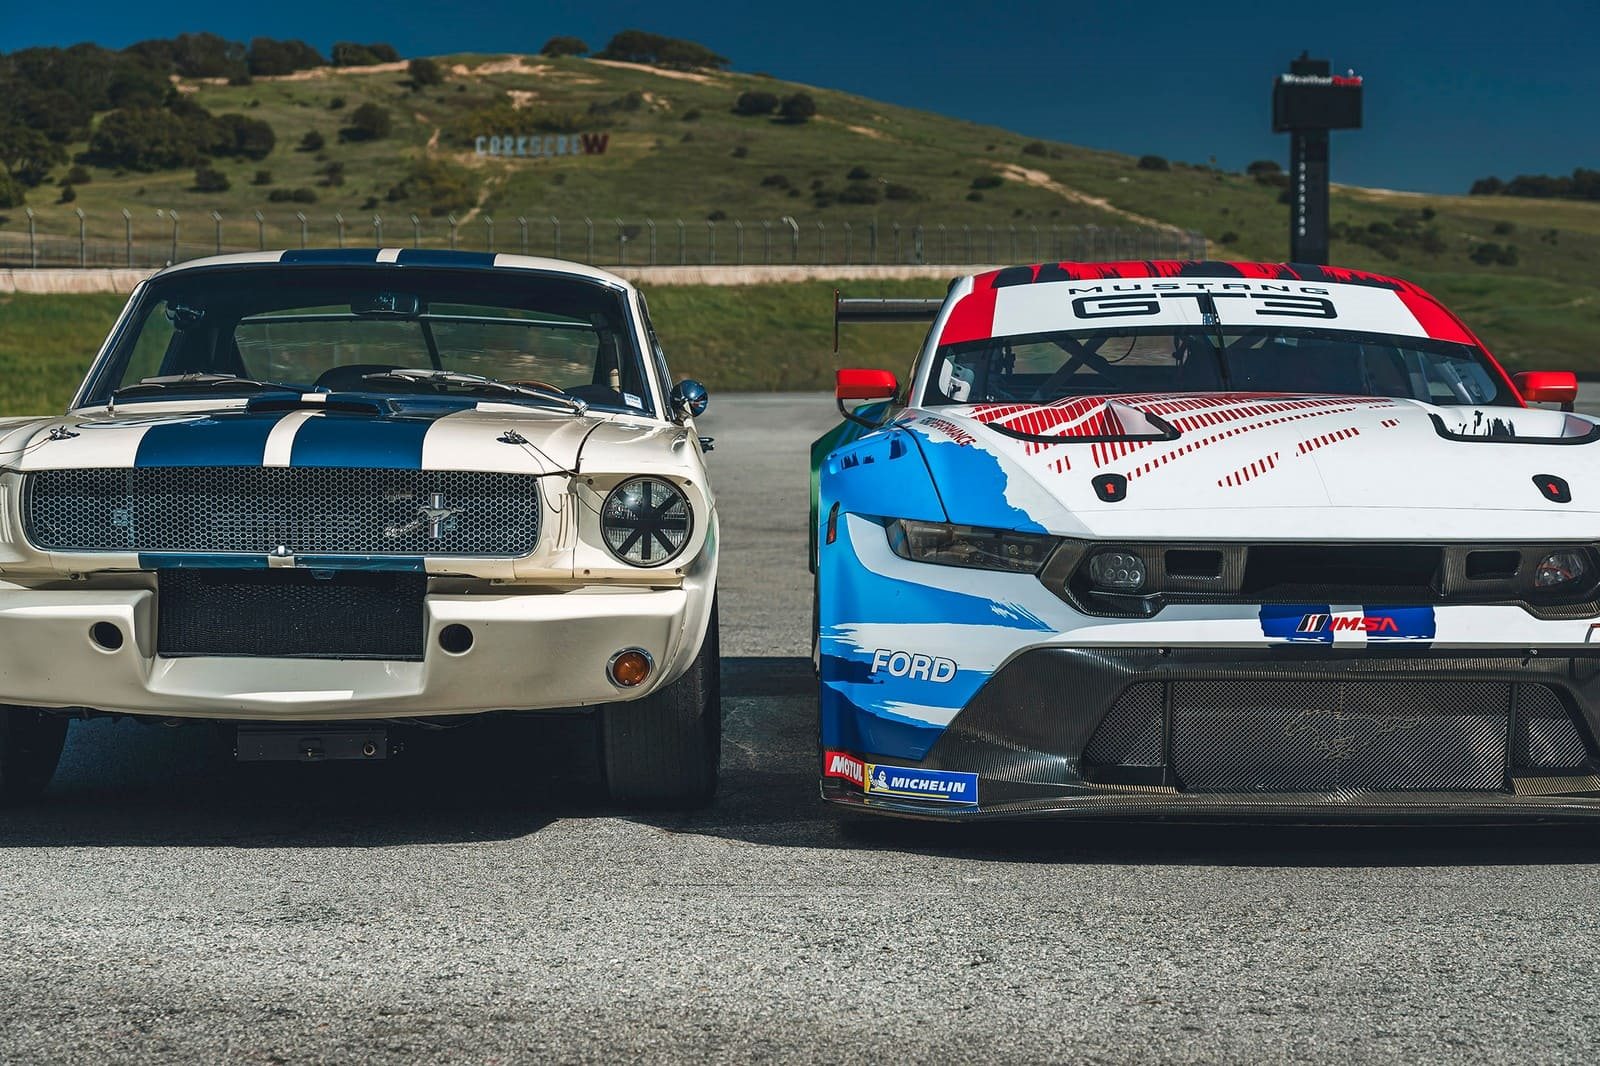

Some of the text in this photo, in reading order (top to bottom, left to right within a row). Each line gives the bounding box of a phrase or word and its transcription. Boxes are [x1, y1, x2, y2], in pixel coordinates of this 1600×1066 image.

[1068, 283, 1331, 295] MUSTANG
[1071, 293, 1338, 319] GT3
[1328, 616, 1399, 631] IMSA
[870, 648, 958, 683] FORD
[829, 755, 864, 782] MOTUL
[890, 776, 966, 793] MICHELIN
